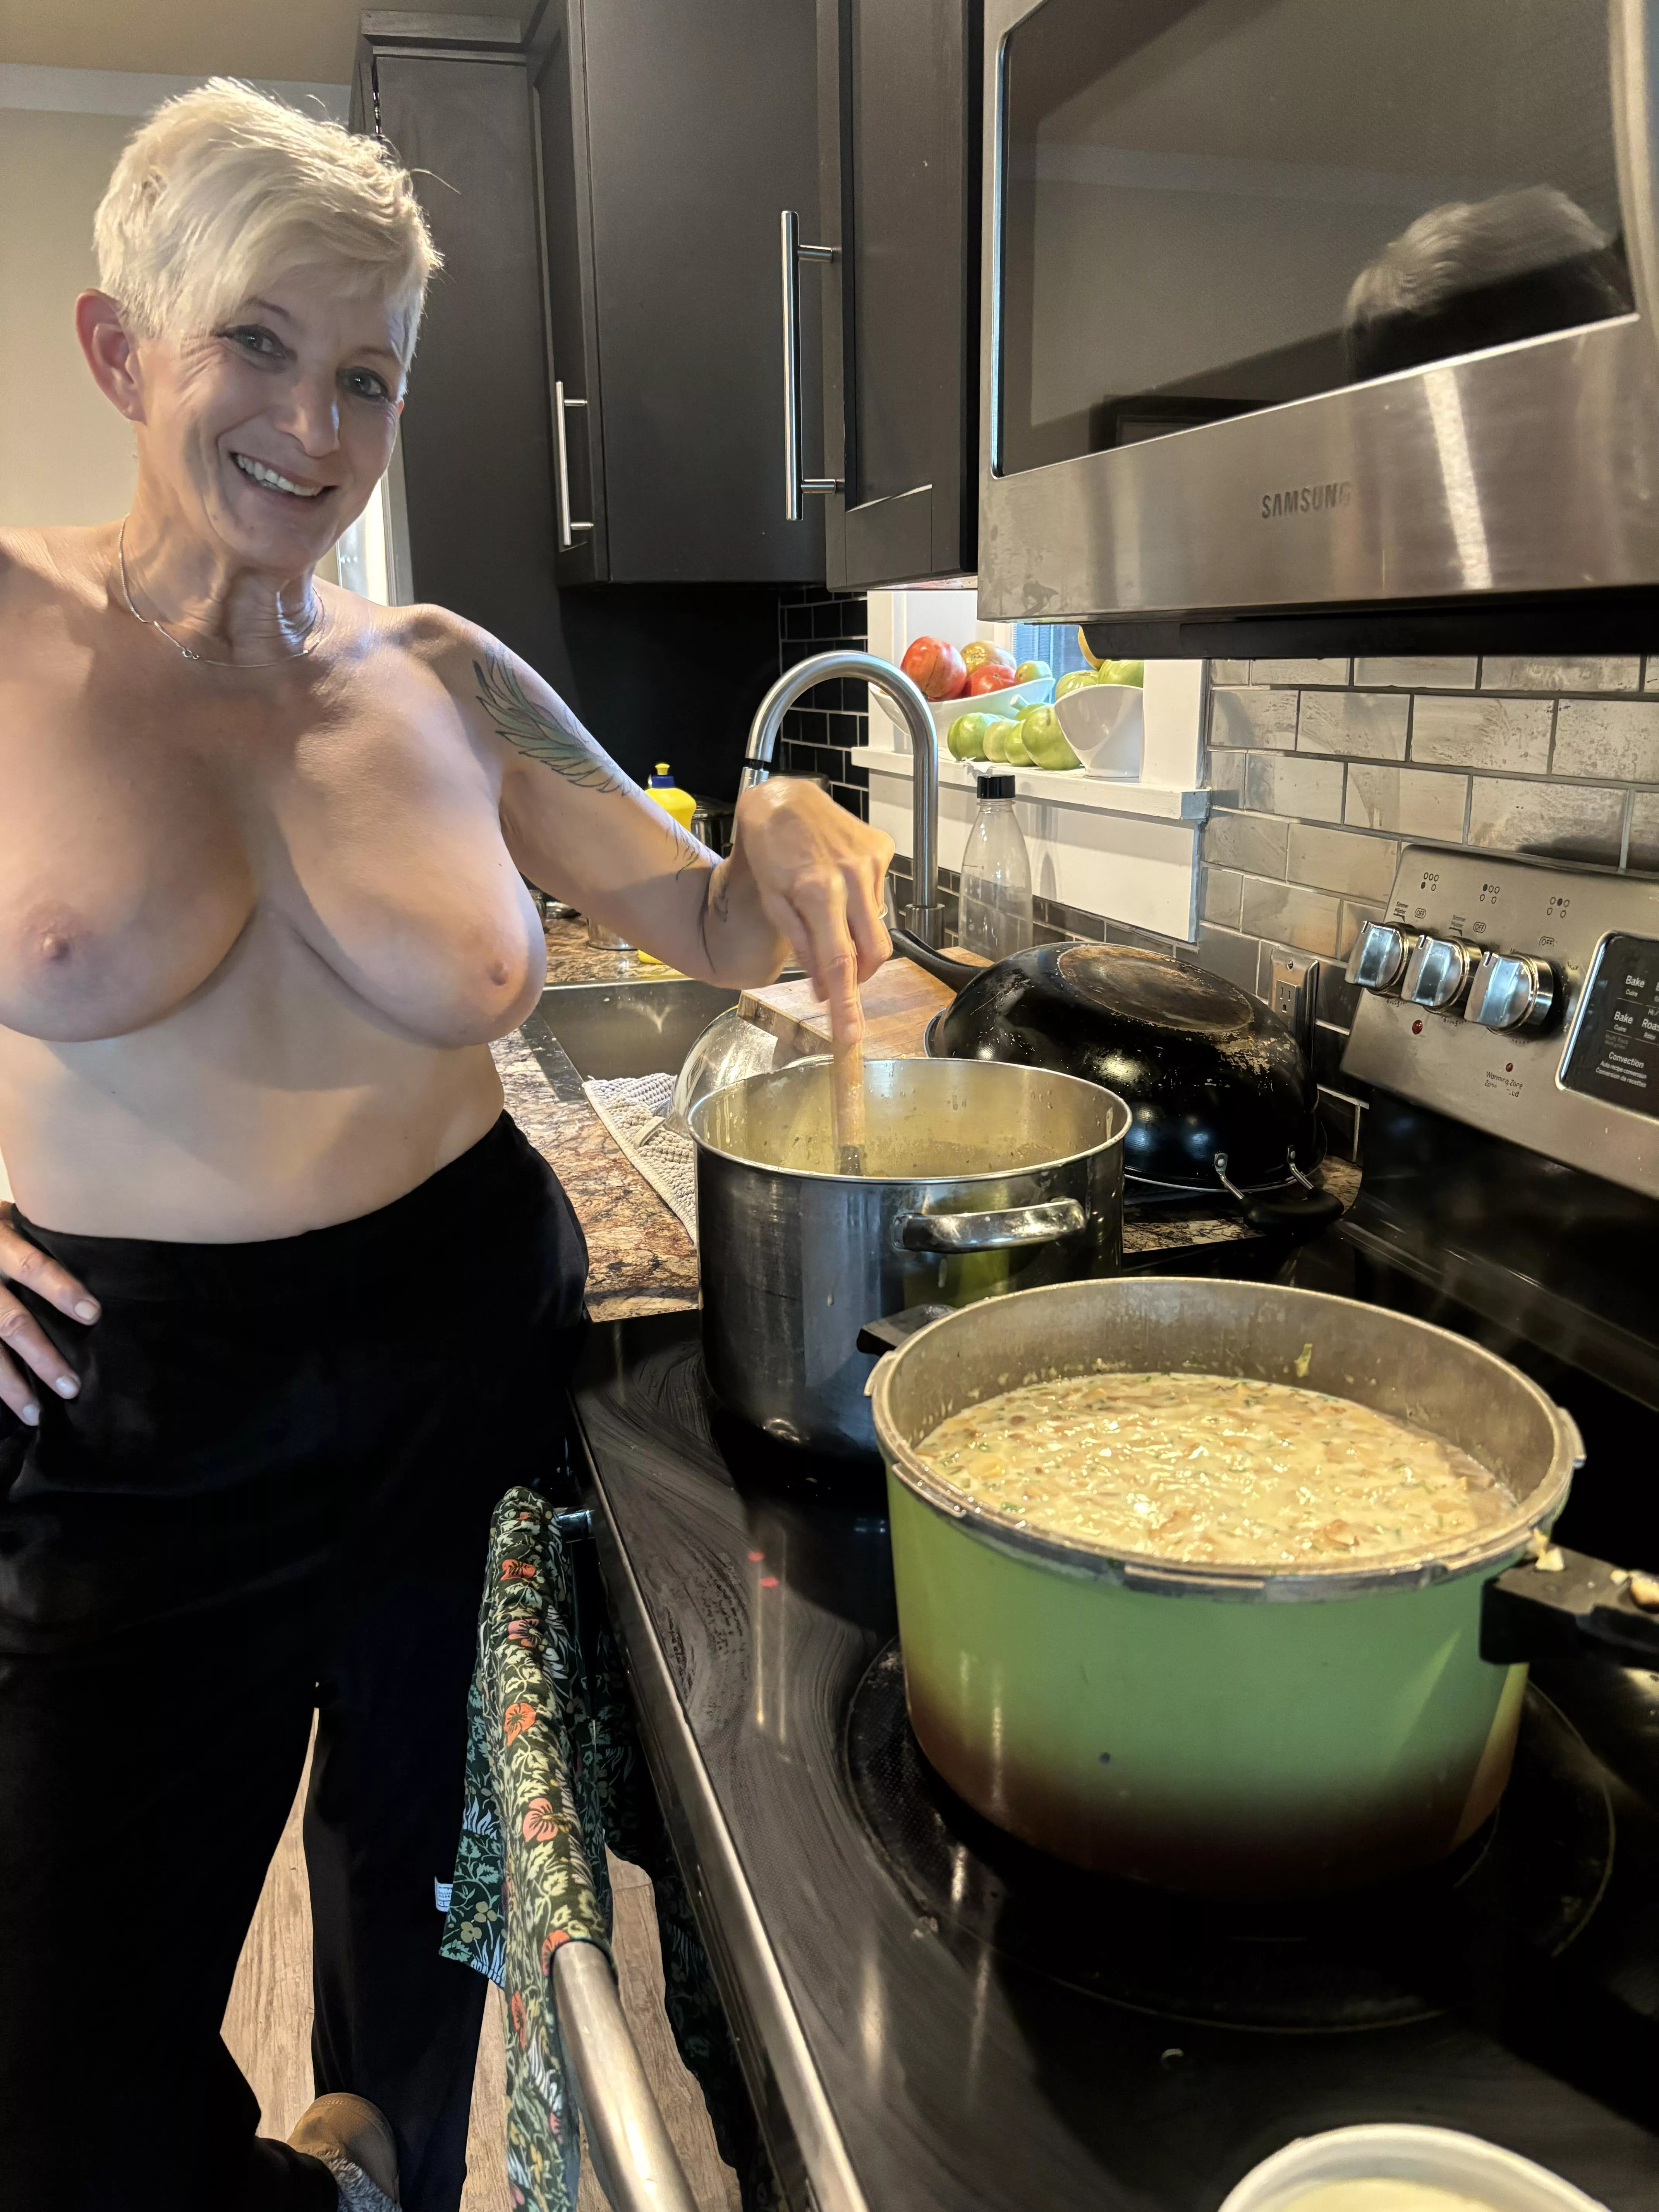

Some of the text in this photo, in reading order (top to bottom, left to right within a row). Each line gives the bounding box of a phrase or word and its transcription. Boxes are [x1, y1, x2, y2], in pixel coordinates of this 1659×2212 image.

[1625, 975, 1645, 988] Bake
[1614, 1011, 1633, 1024] Bake
[1609, 1051, 1645, 1068] Convection
[1486, 1071, 1523, 1089] Warming Zone
